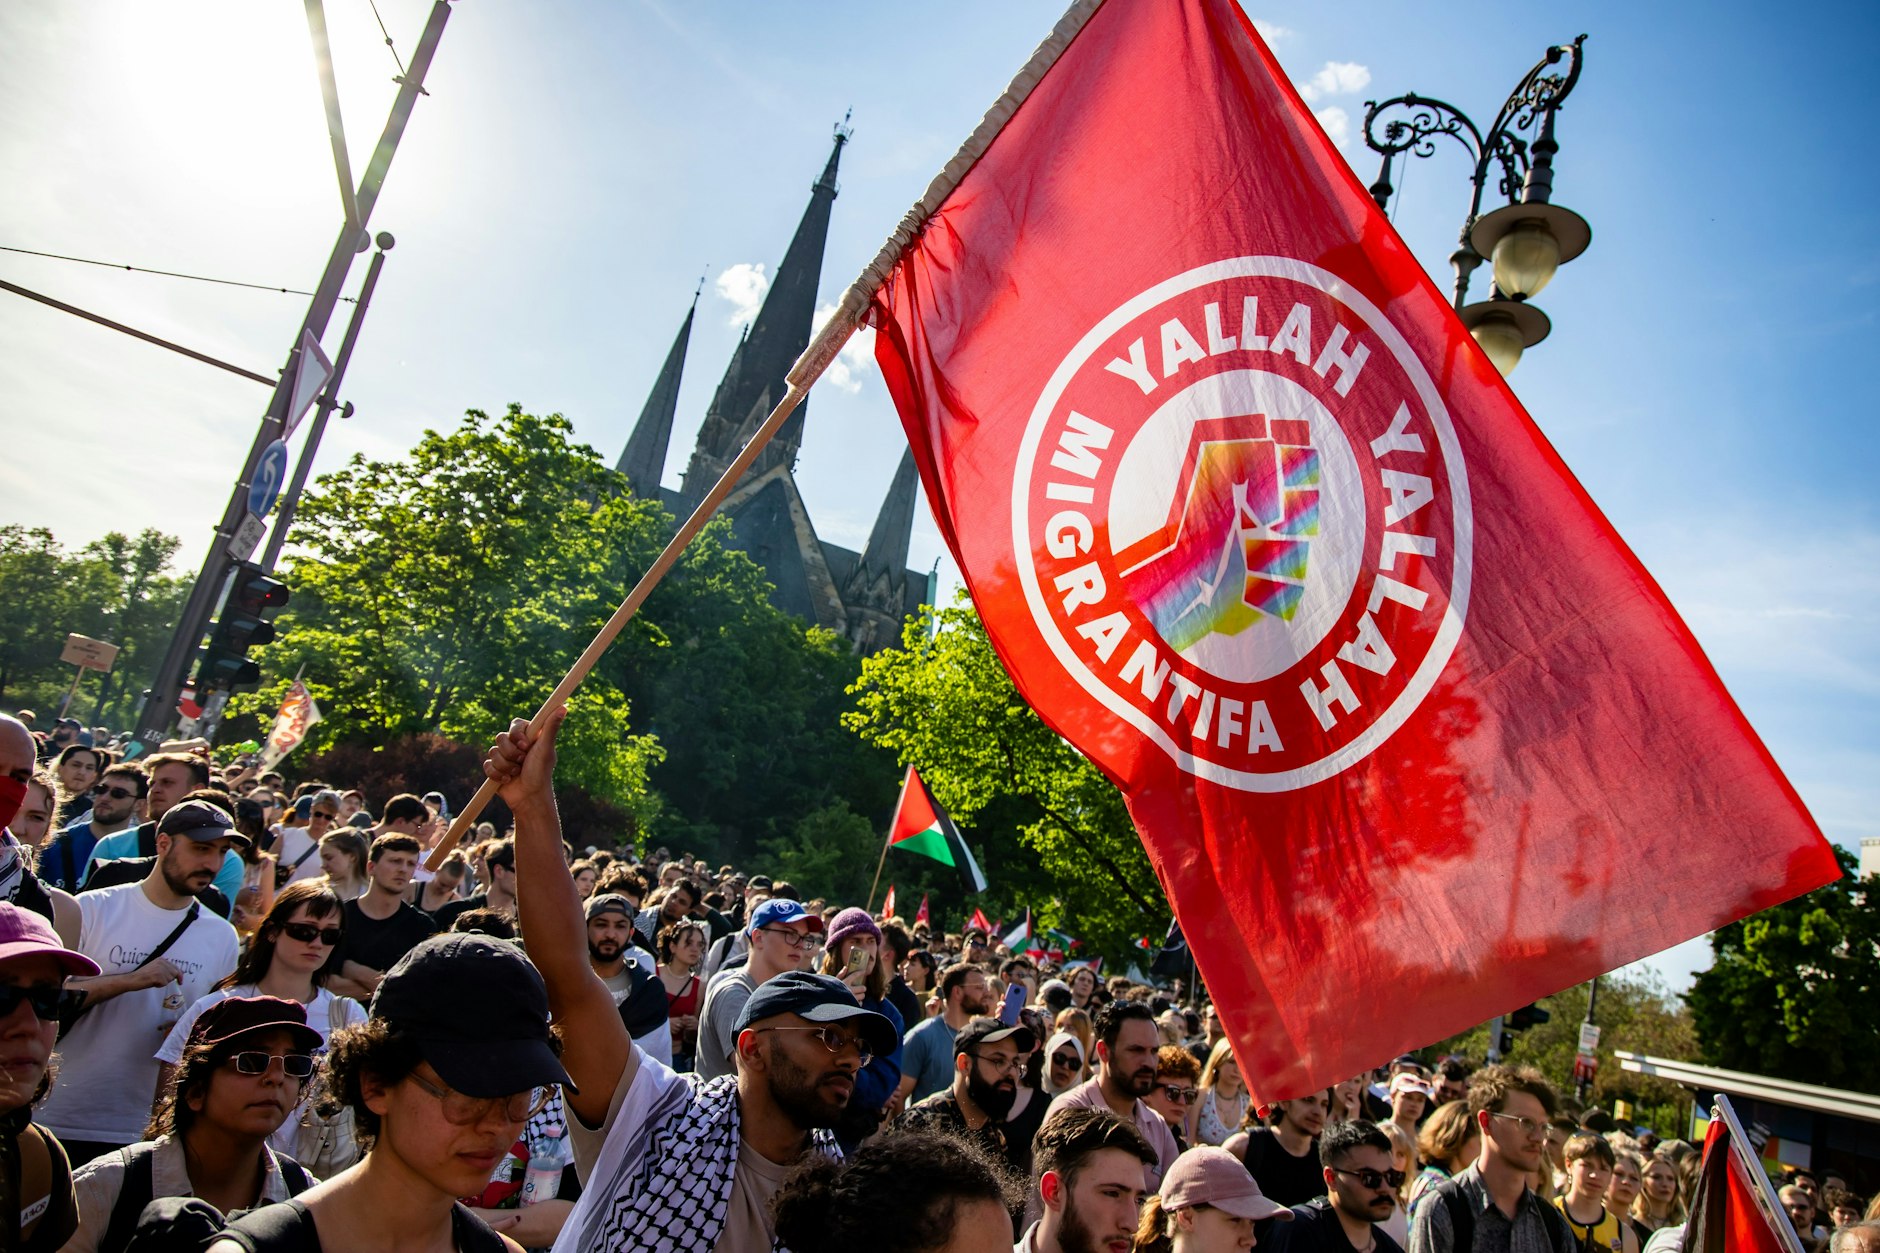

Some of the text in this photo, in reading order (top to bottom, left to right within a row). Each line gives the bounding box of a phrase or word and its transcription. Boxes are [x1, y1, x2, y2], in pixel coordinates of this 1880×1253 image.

[1044, 410, 1285, 755] MIGRANTIFA
[1104, 295, 1437, 733] YALLAH YALLAH
